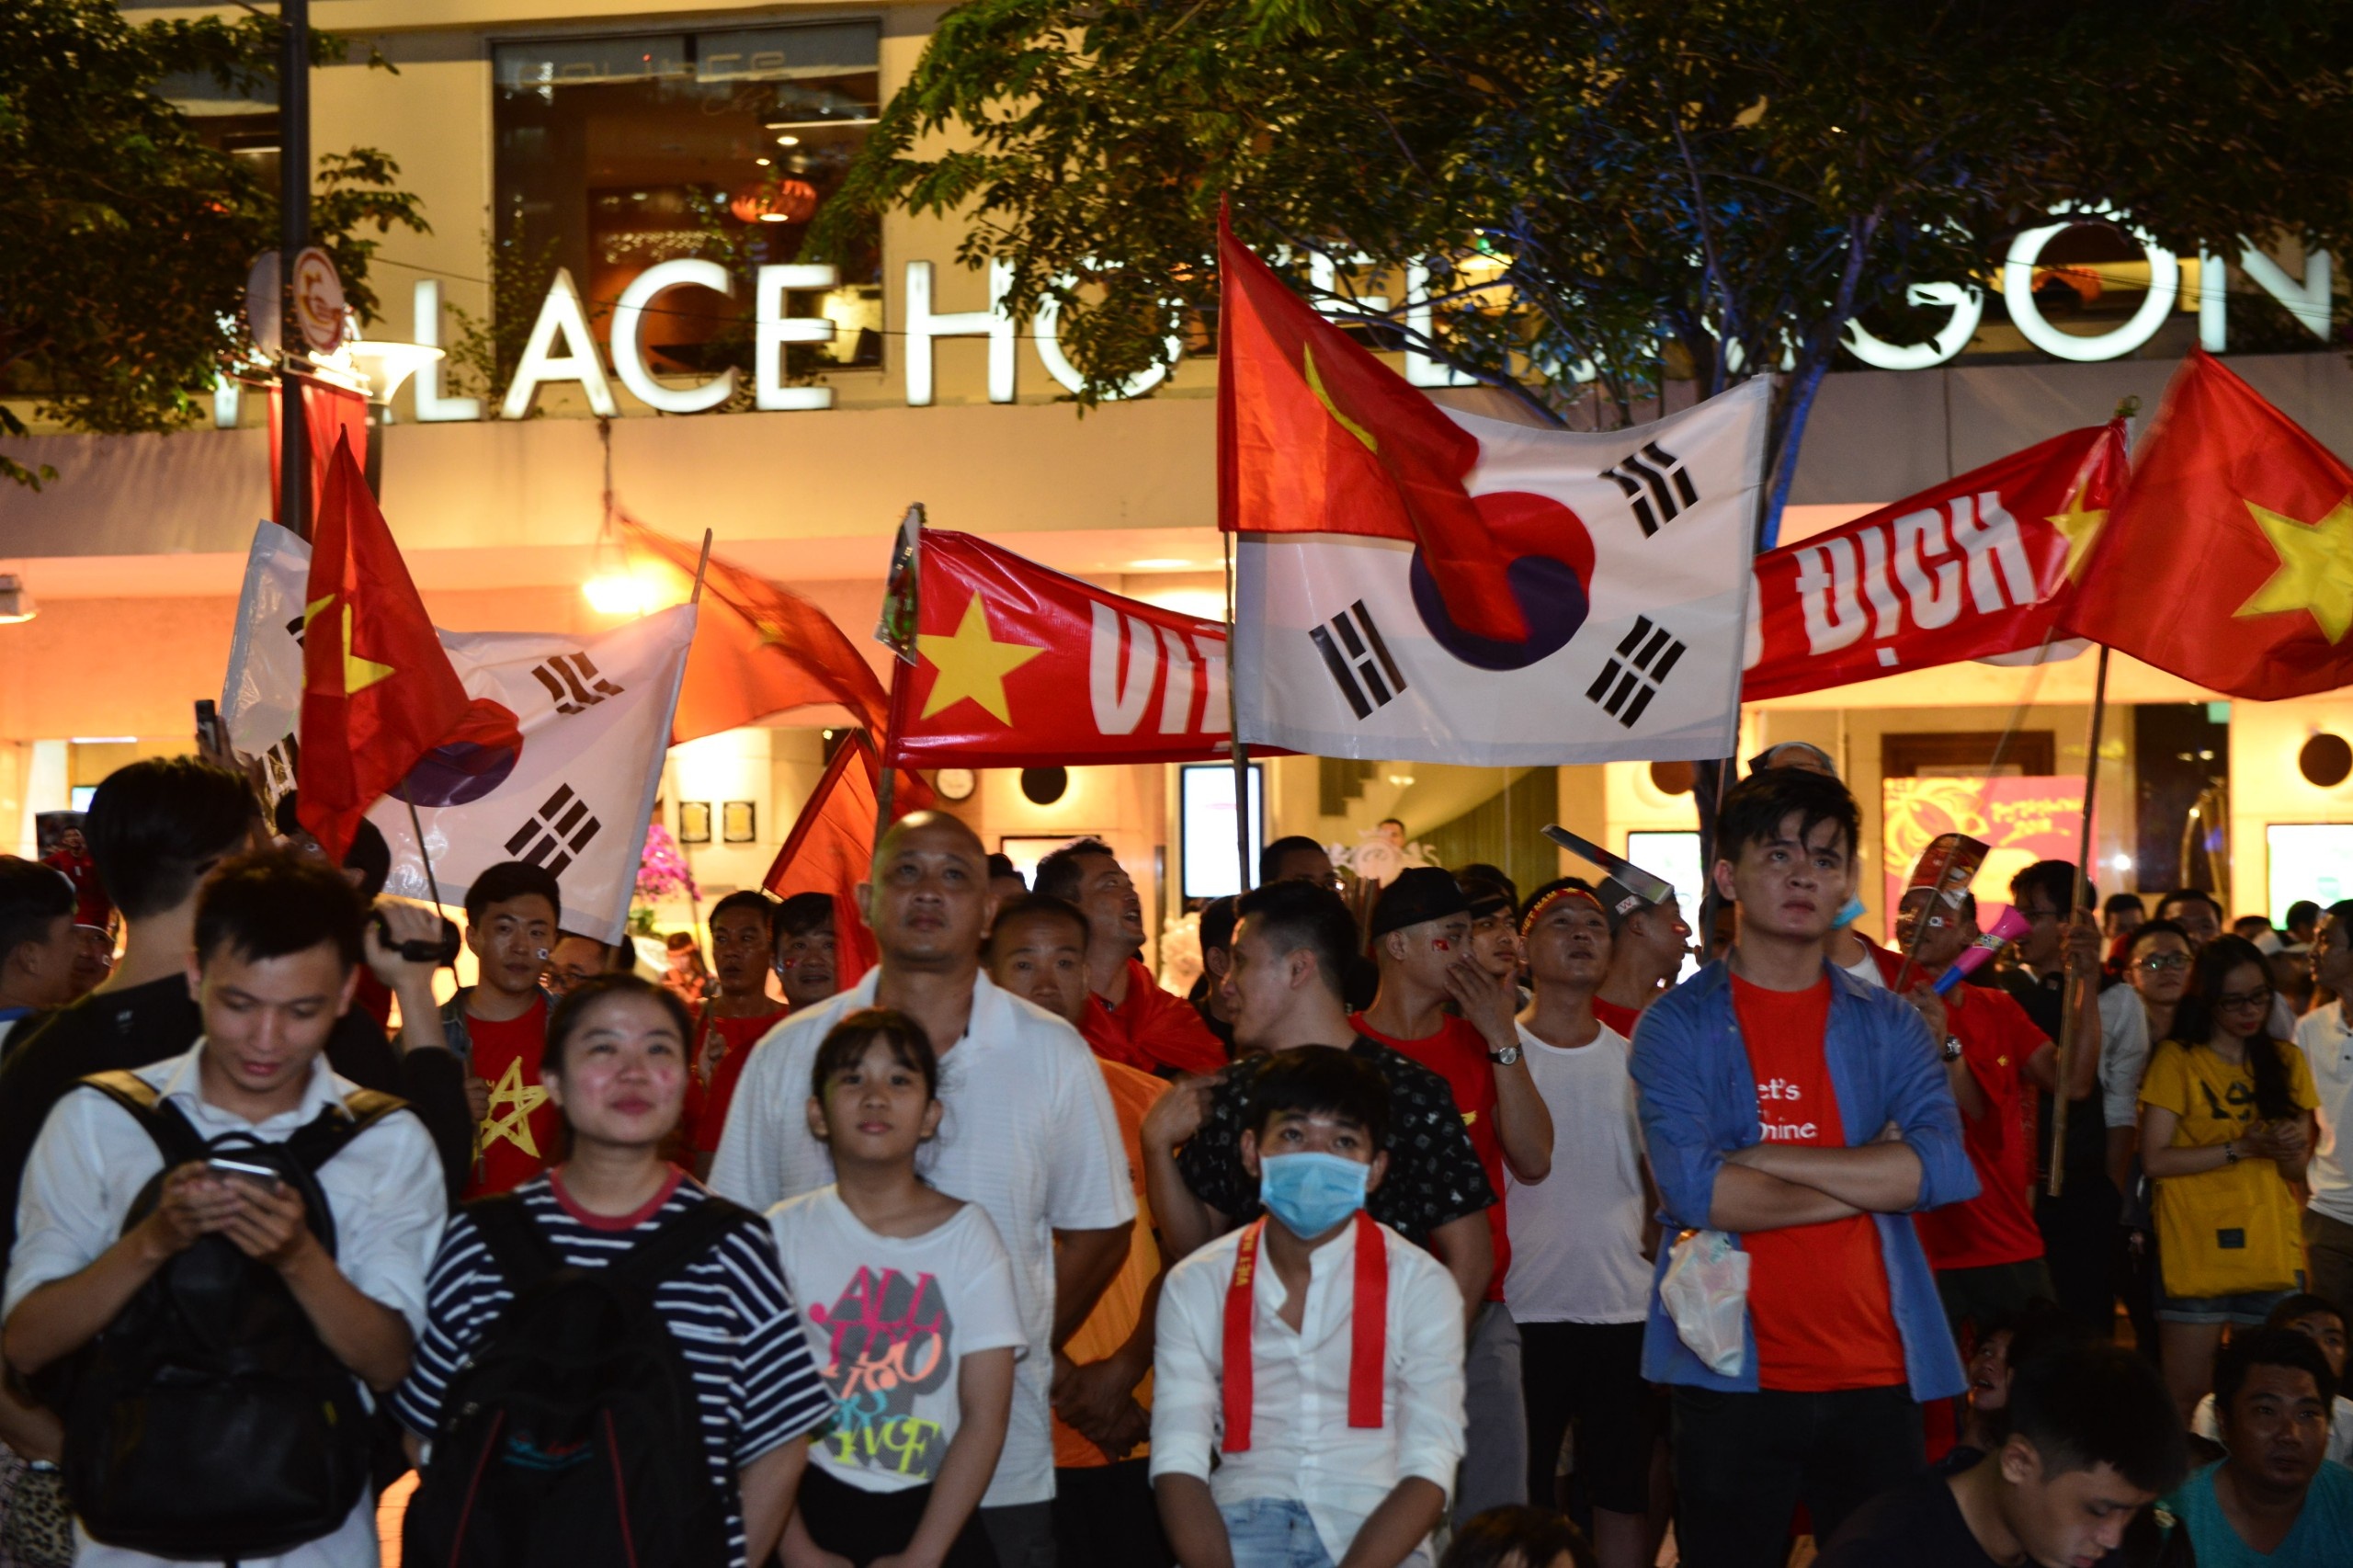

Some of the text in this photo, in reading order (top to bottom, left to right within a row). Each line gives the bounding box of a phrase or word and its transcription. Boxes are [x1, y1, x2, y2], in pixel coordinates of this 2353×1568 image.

[905, 242, 1482, 406] HOEL
[1794, 490, 2038, 666] ĐỊCH
[1757, 1078, 1802, 1100] et's
[808, 1265, 945, 1335] ALL
[823, 1406, 942, 1480] ANCE
